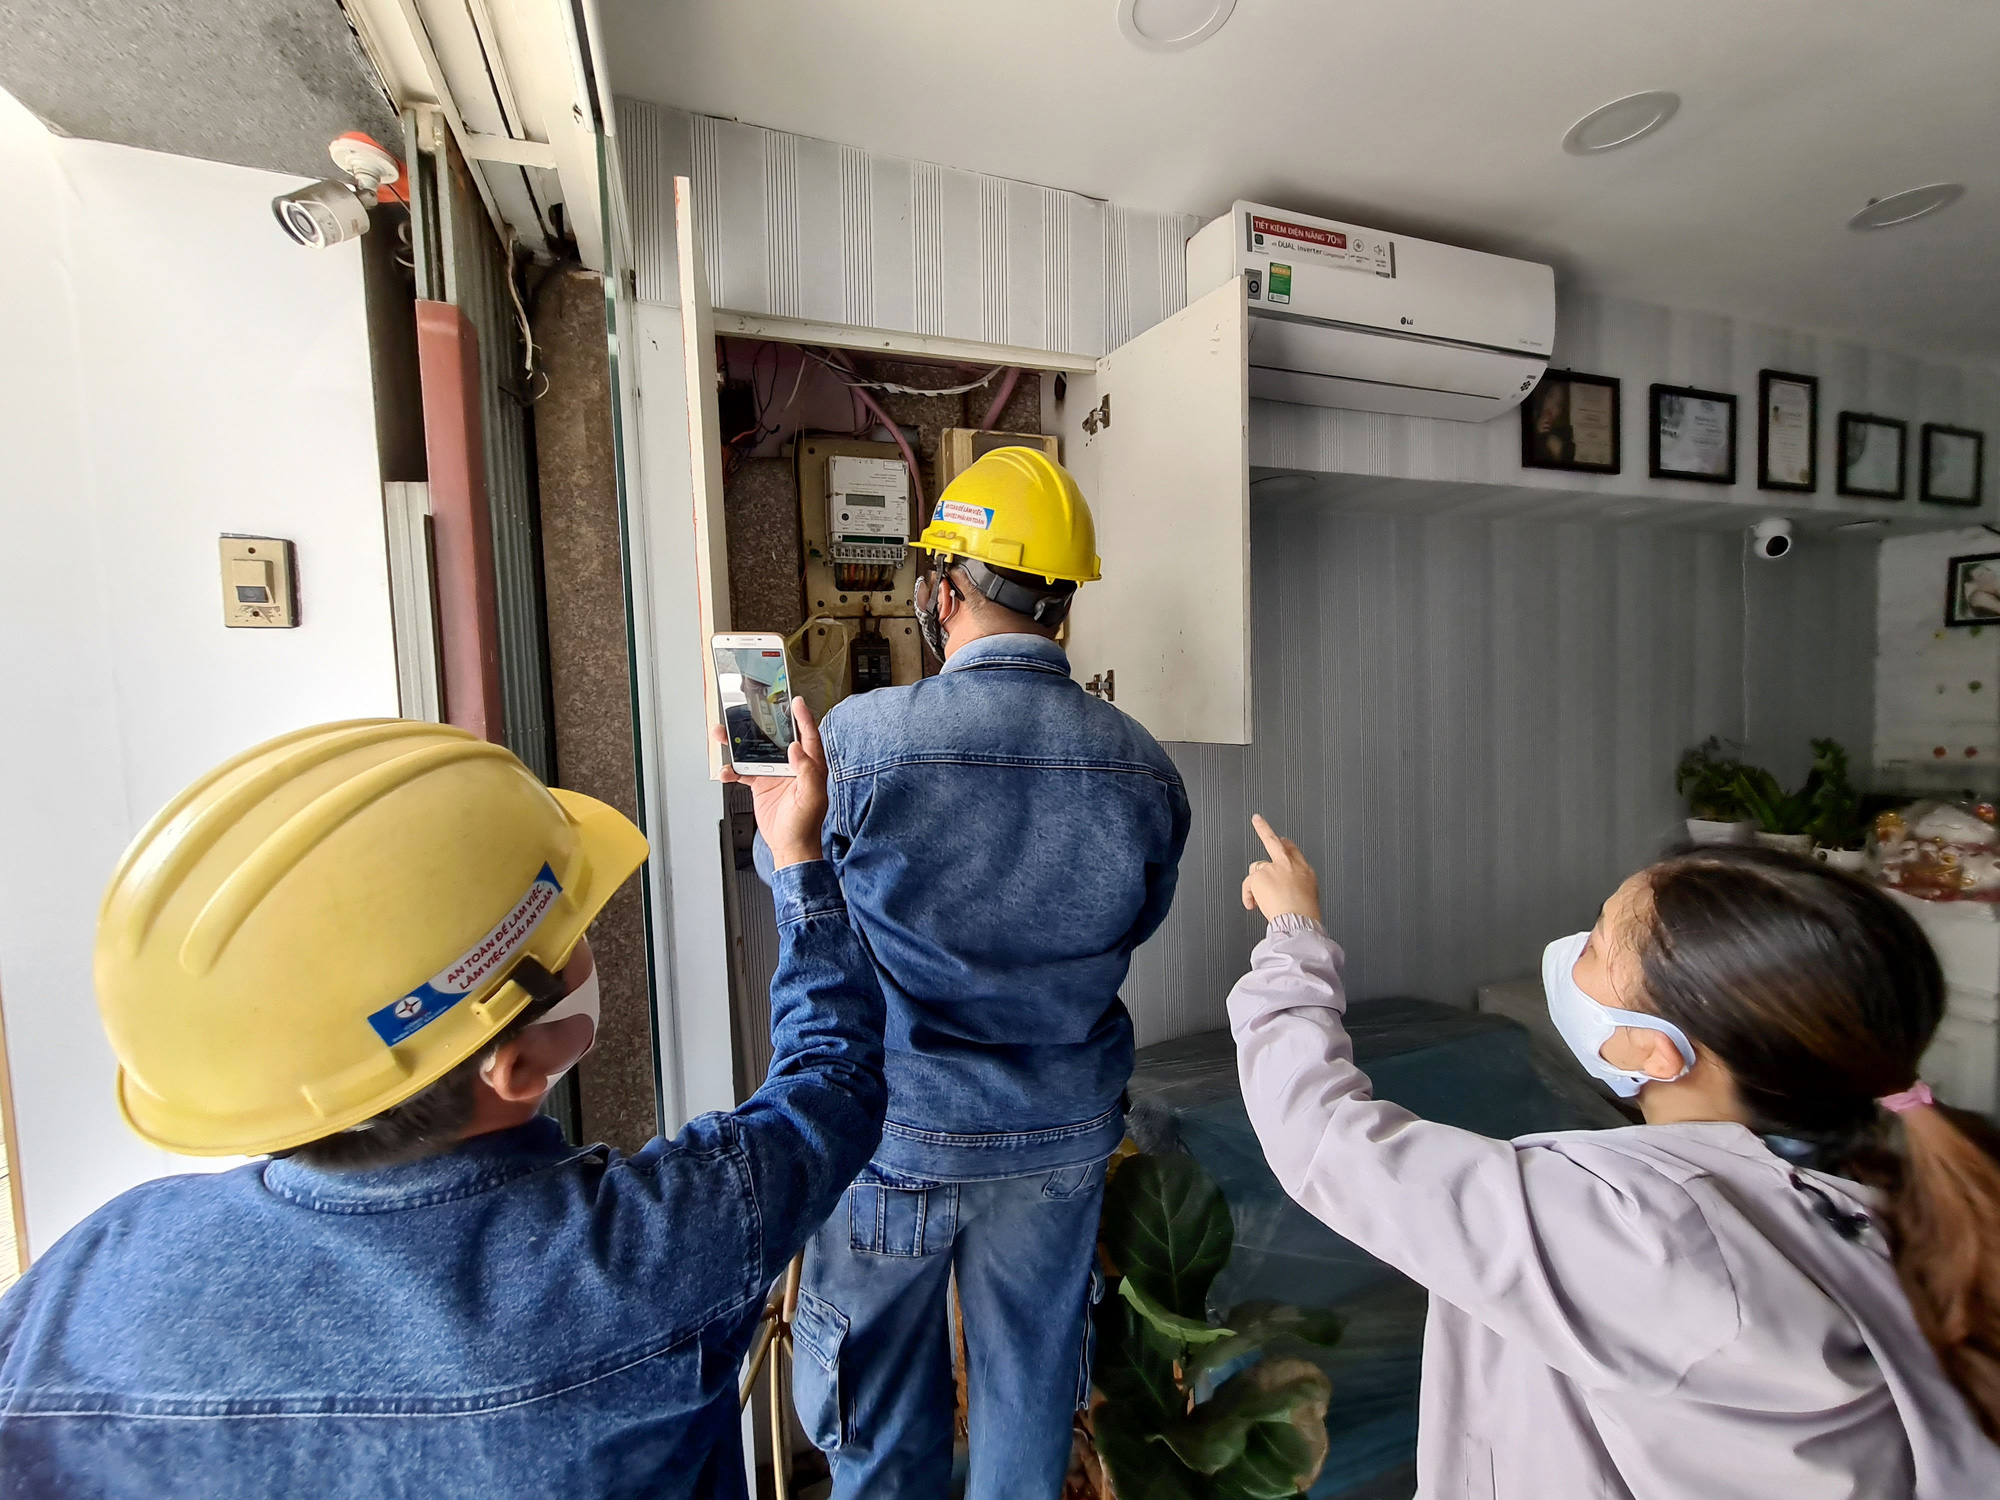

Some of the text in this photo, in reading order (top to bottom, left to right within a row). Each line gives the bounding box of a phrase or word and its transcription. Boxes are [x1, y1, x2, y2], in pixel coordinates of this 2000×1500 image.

[1278, 241, 1296, 251] DUAL
[1297, 245, 1322, 255] Inverter
[447, 884, 543, 983] AN TOÀN ĐỂ LÀM VIỆC
[459, 888, 553, 990] LÀM VIỆC PHẢI AN TOÀN
